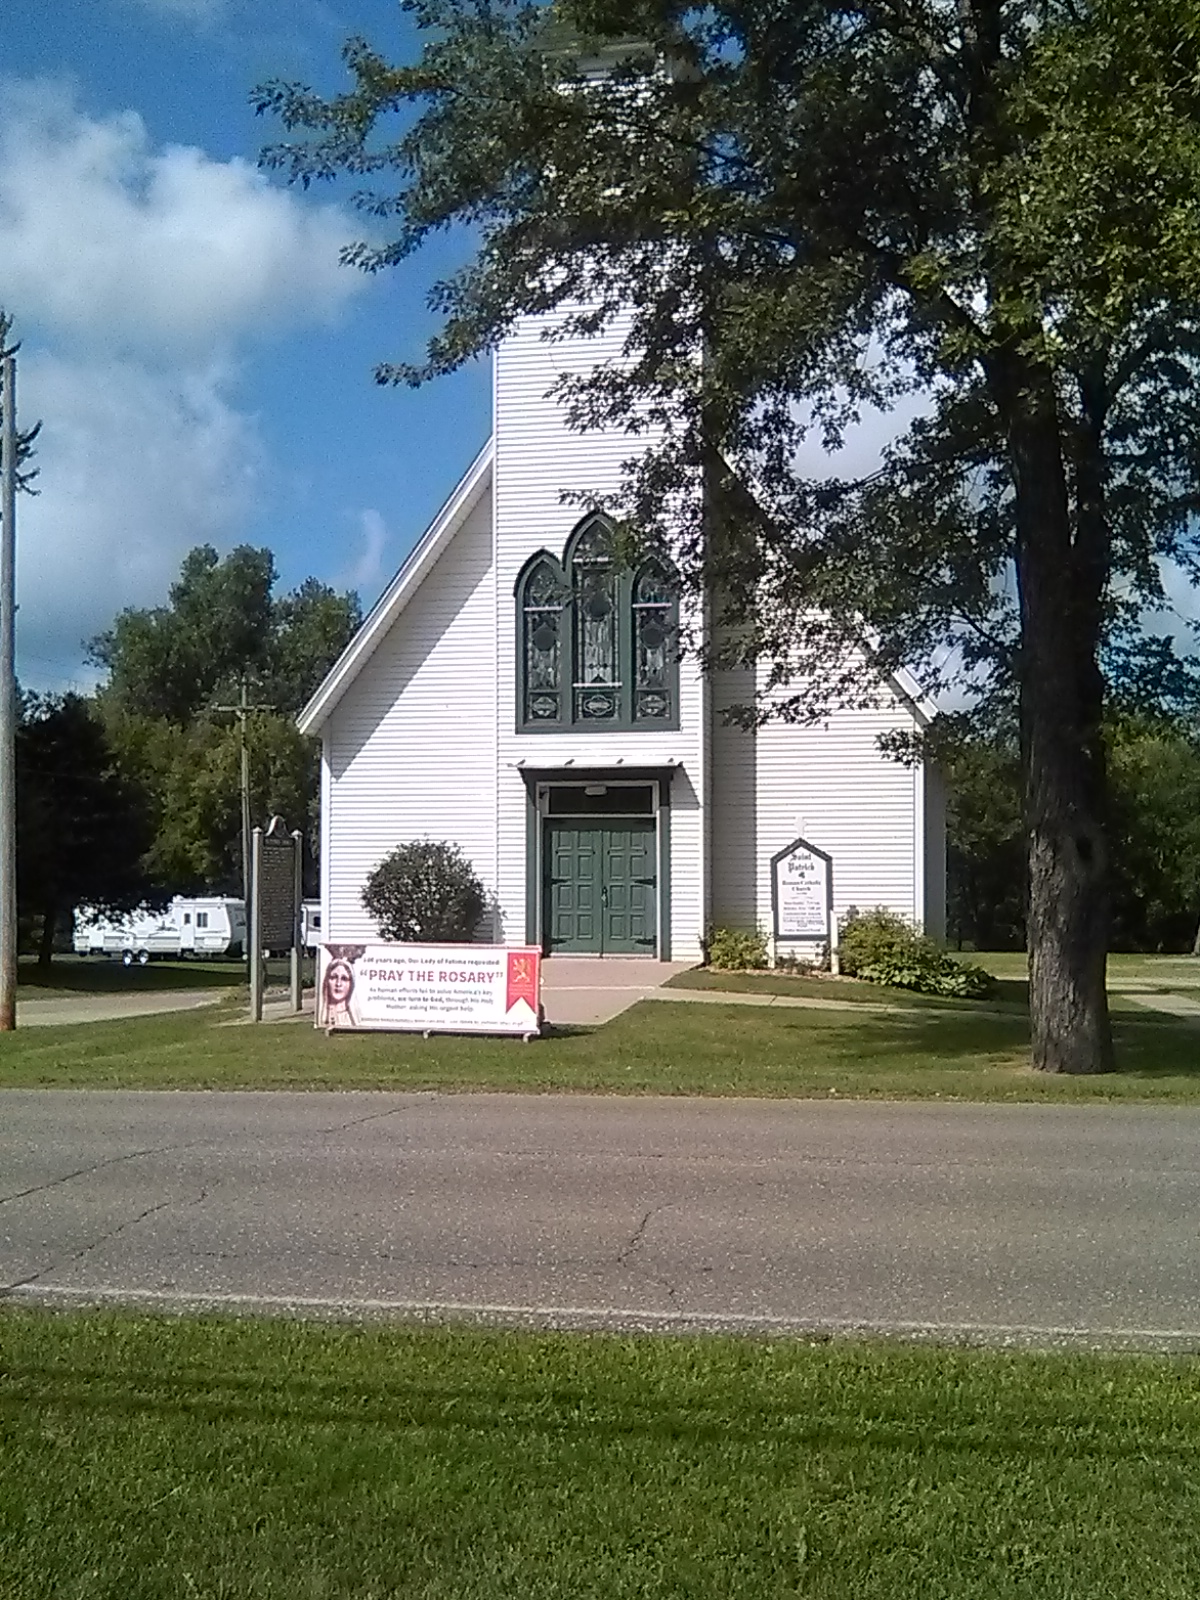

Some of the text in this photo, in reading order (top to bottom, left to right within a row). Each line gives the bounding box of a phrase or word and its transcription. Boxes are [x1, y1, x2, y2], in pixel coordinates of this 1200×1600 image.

[790, 851, 812, 861] Saint
[788, 862, 815, 873] Patrick
[407, 970, 434, 982] THE
